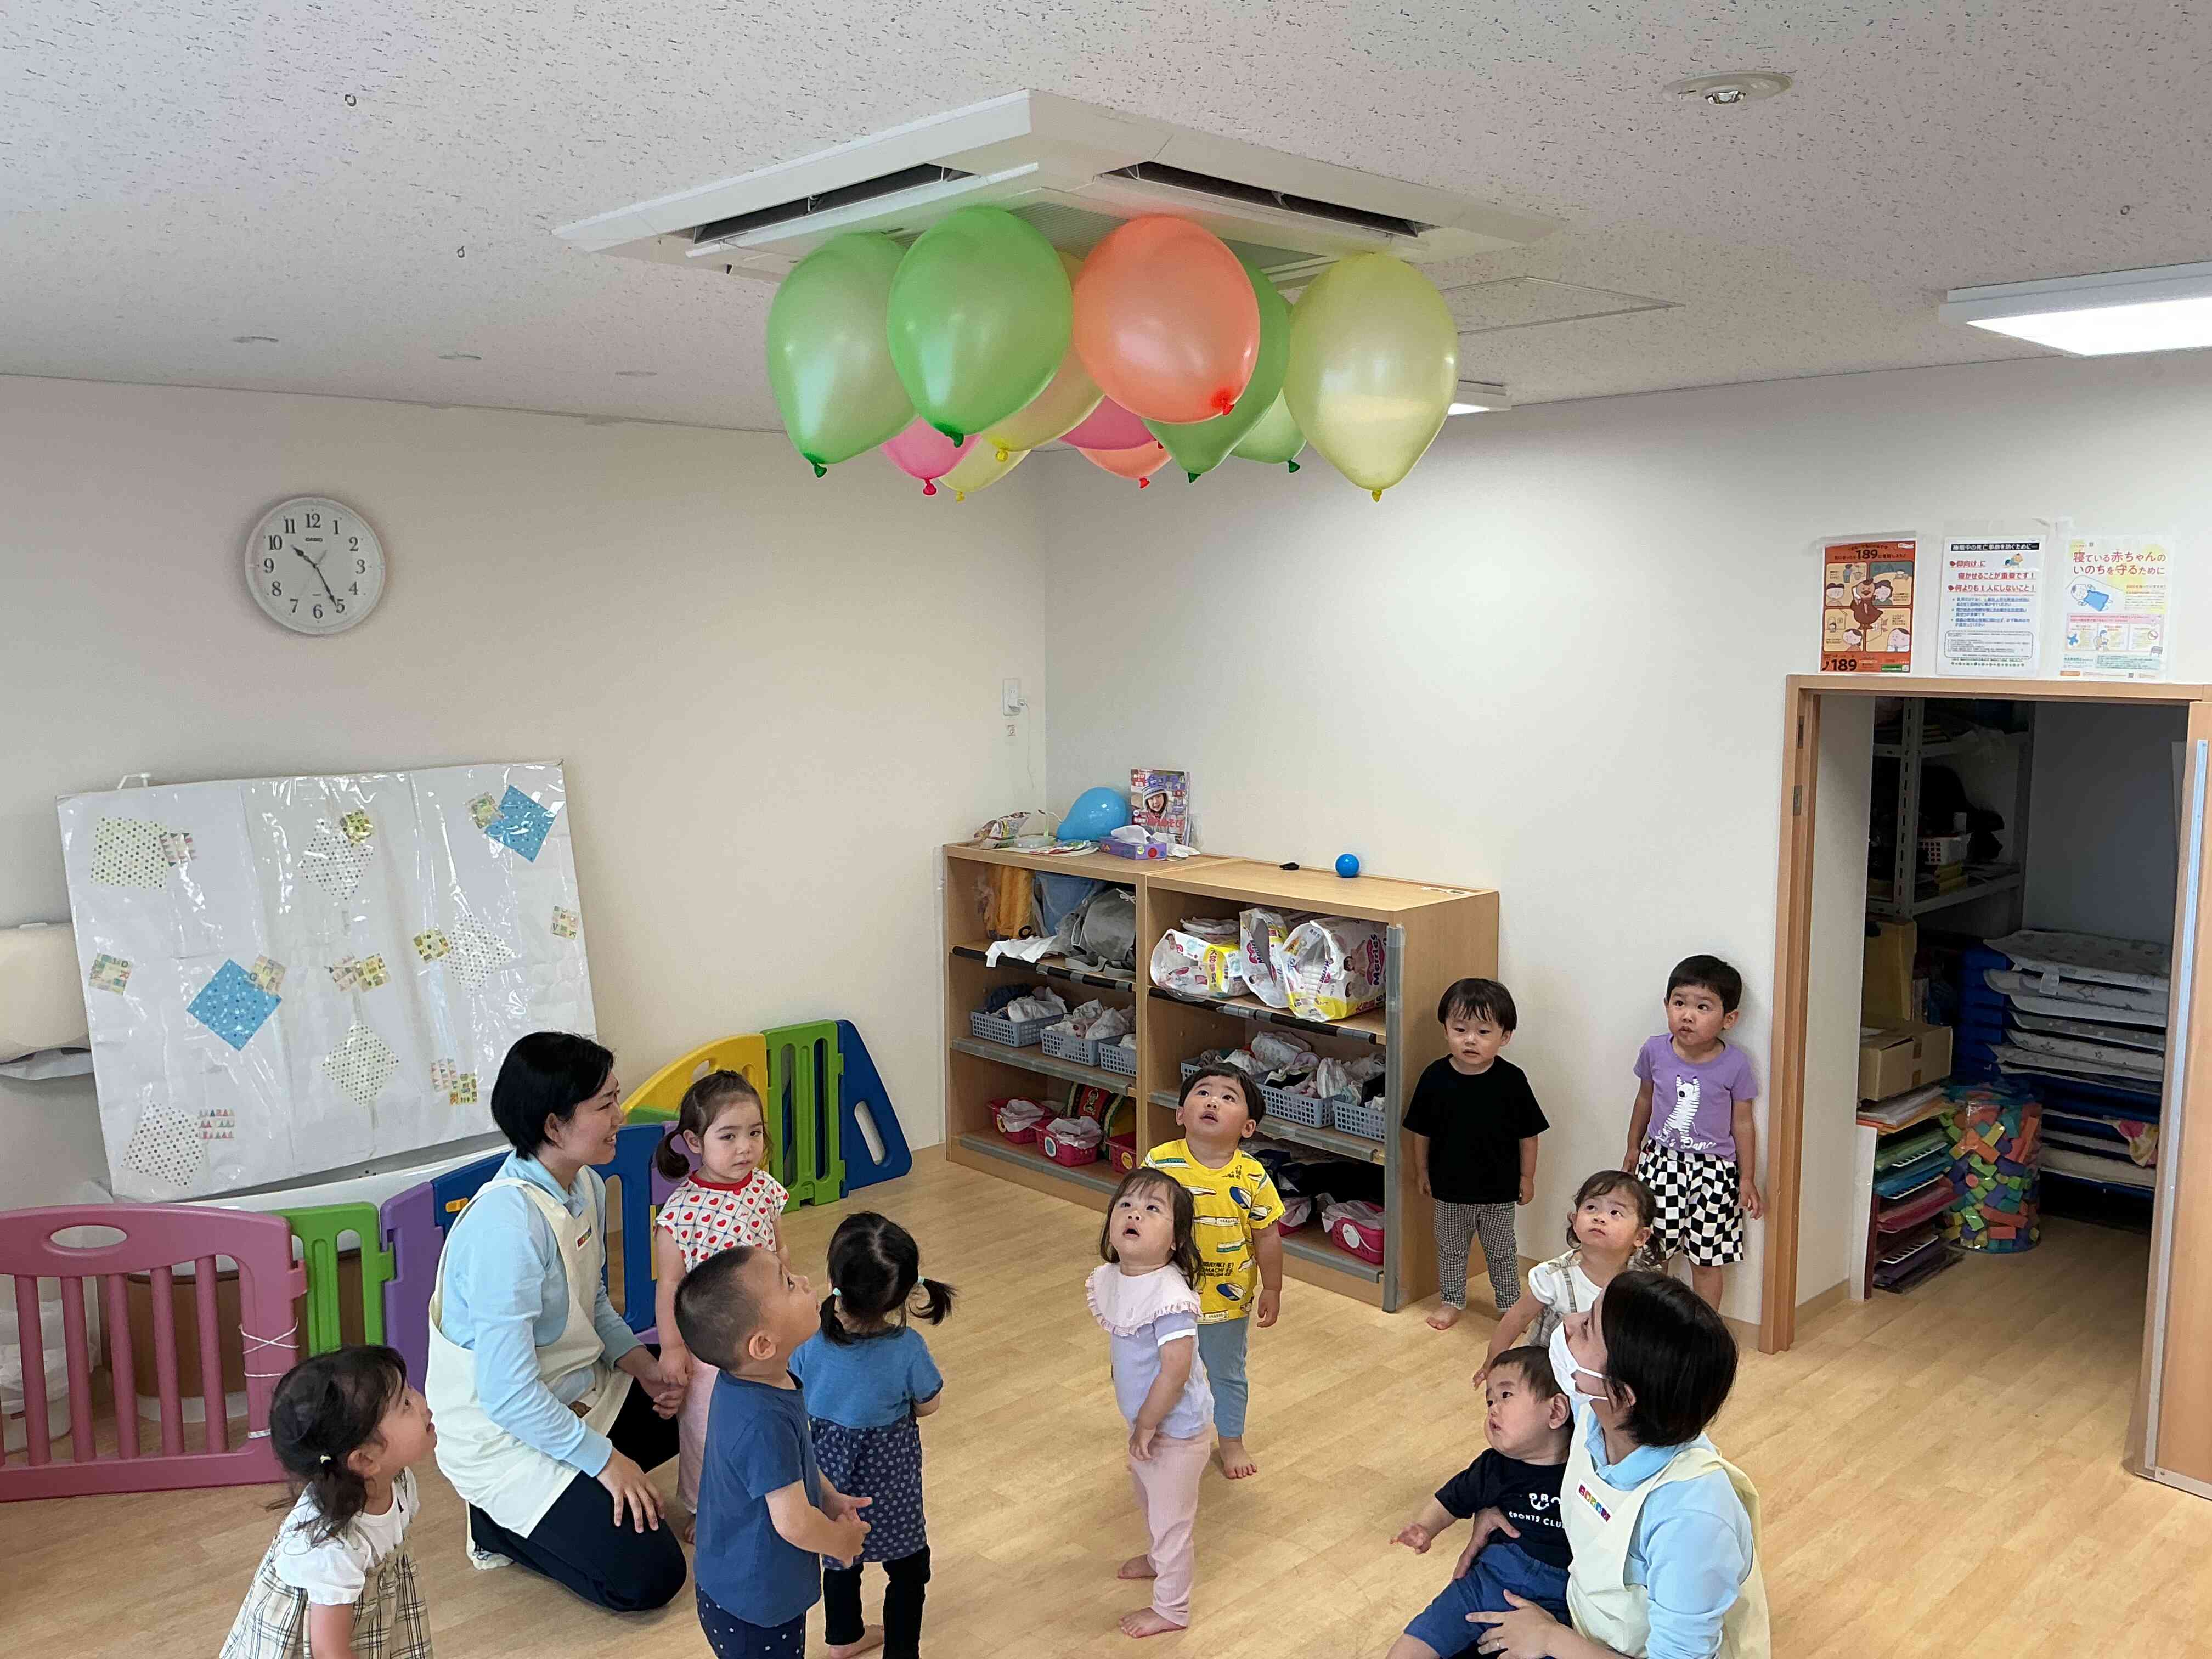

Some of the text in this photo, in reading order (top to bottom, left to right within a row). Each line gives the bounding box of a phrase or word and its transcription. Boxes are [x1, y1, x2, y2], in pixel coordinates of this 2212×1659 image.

[284, 518, 295, 534] 11
[306, 513, 321, 528] 12
[332, 520, 339, 535] 1
[268, 534, 283, 550] 10
[348, 537, 359, 551] 2
[1856, 549, 1878, 560] 189
[2073, 551, 2166, 563] 寝ている赤ちゃんの
[264, 558, 274, 573] 9
[356, 559, 365, 574] 3
[2074, 564, 2165, 575] いのちを守るために
[272, 581, 282, 596] 8
[348, 581, 358, 595] 4
[289, 598, 298, 613] 7
[313, 604, 323, 619] 6
[336, 599, 345, 613] 5
[1831, 658, 1858, 672] 189
[1543, 1517, 1562, 1528] CLU
